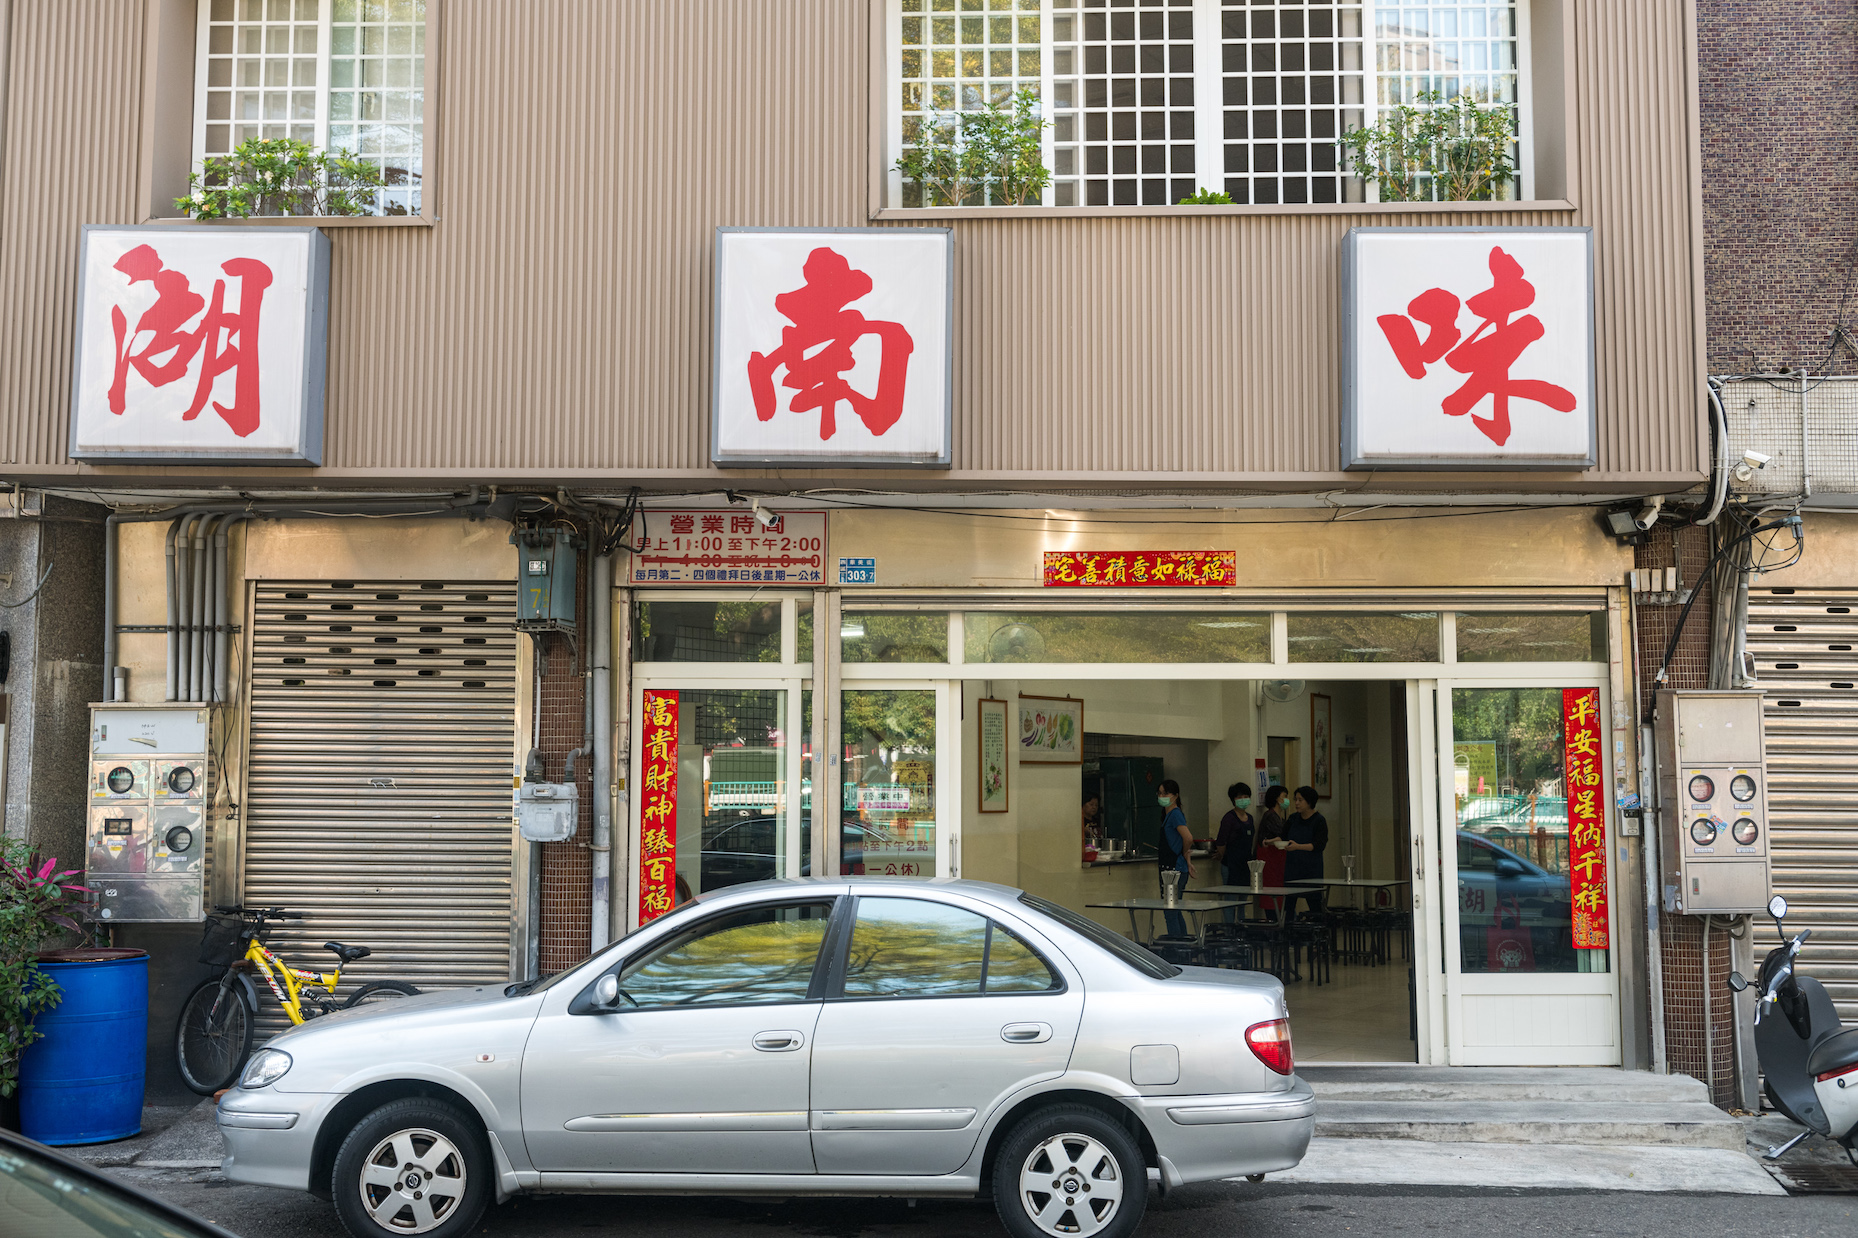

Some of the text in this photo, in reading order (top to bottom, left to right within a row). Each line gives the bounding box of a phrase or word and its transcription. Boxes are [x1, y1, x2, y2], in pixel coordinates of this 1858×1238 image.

[108, 244, 1576, 446] 湖 南 味
